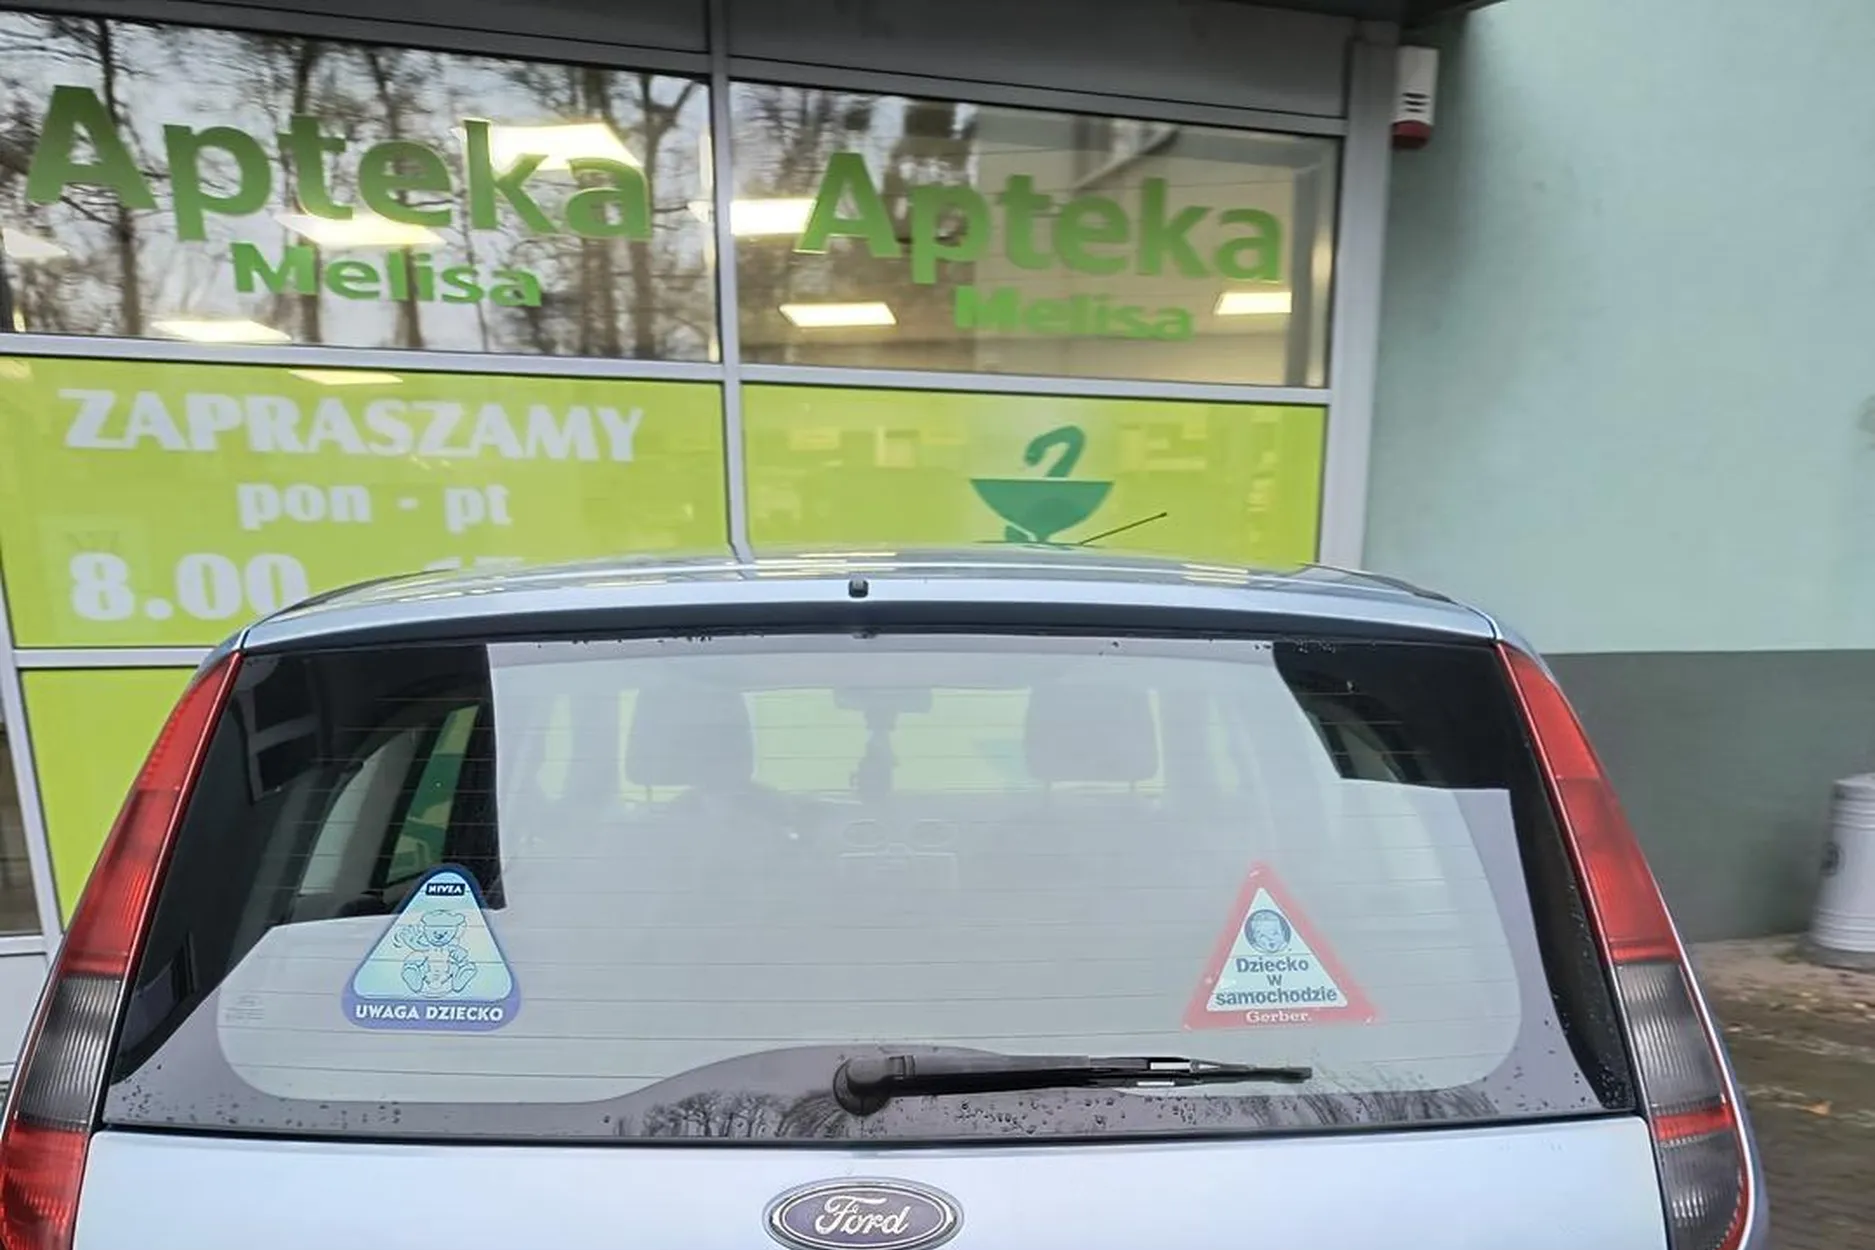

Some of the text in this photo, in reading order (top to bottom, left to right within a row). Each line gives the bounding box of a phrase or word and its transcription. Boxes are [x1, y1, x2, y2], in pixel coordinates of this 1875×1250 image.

[24, 85, 654, 241] Apteka
[795, 152, 1283, 285] Apteka
[231, 242, 542, 307] Melisa
[954, 285, 1195, 341] Melisa
[58, 389, 645, 462] ZAPRASZAMY
[237, 482, 373, 531] pon
[444, 485, 513, 534] pt
[69, 552, 310, 621] 8.00
[427, 884, 462, 894] NIVEA
[1236, 957, 1309, 972] Dziecko
[356, 1005, 503, 1021] UWAGA DZIECKO
[1216, 987, 1338, 1006] samochodzie
[814, 1195, 911, 1234] Ford
